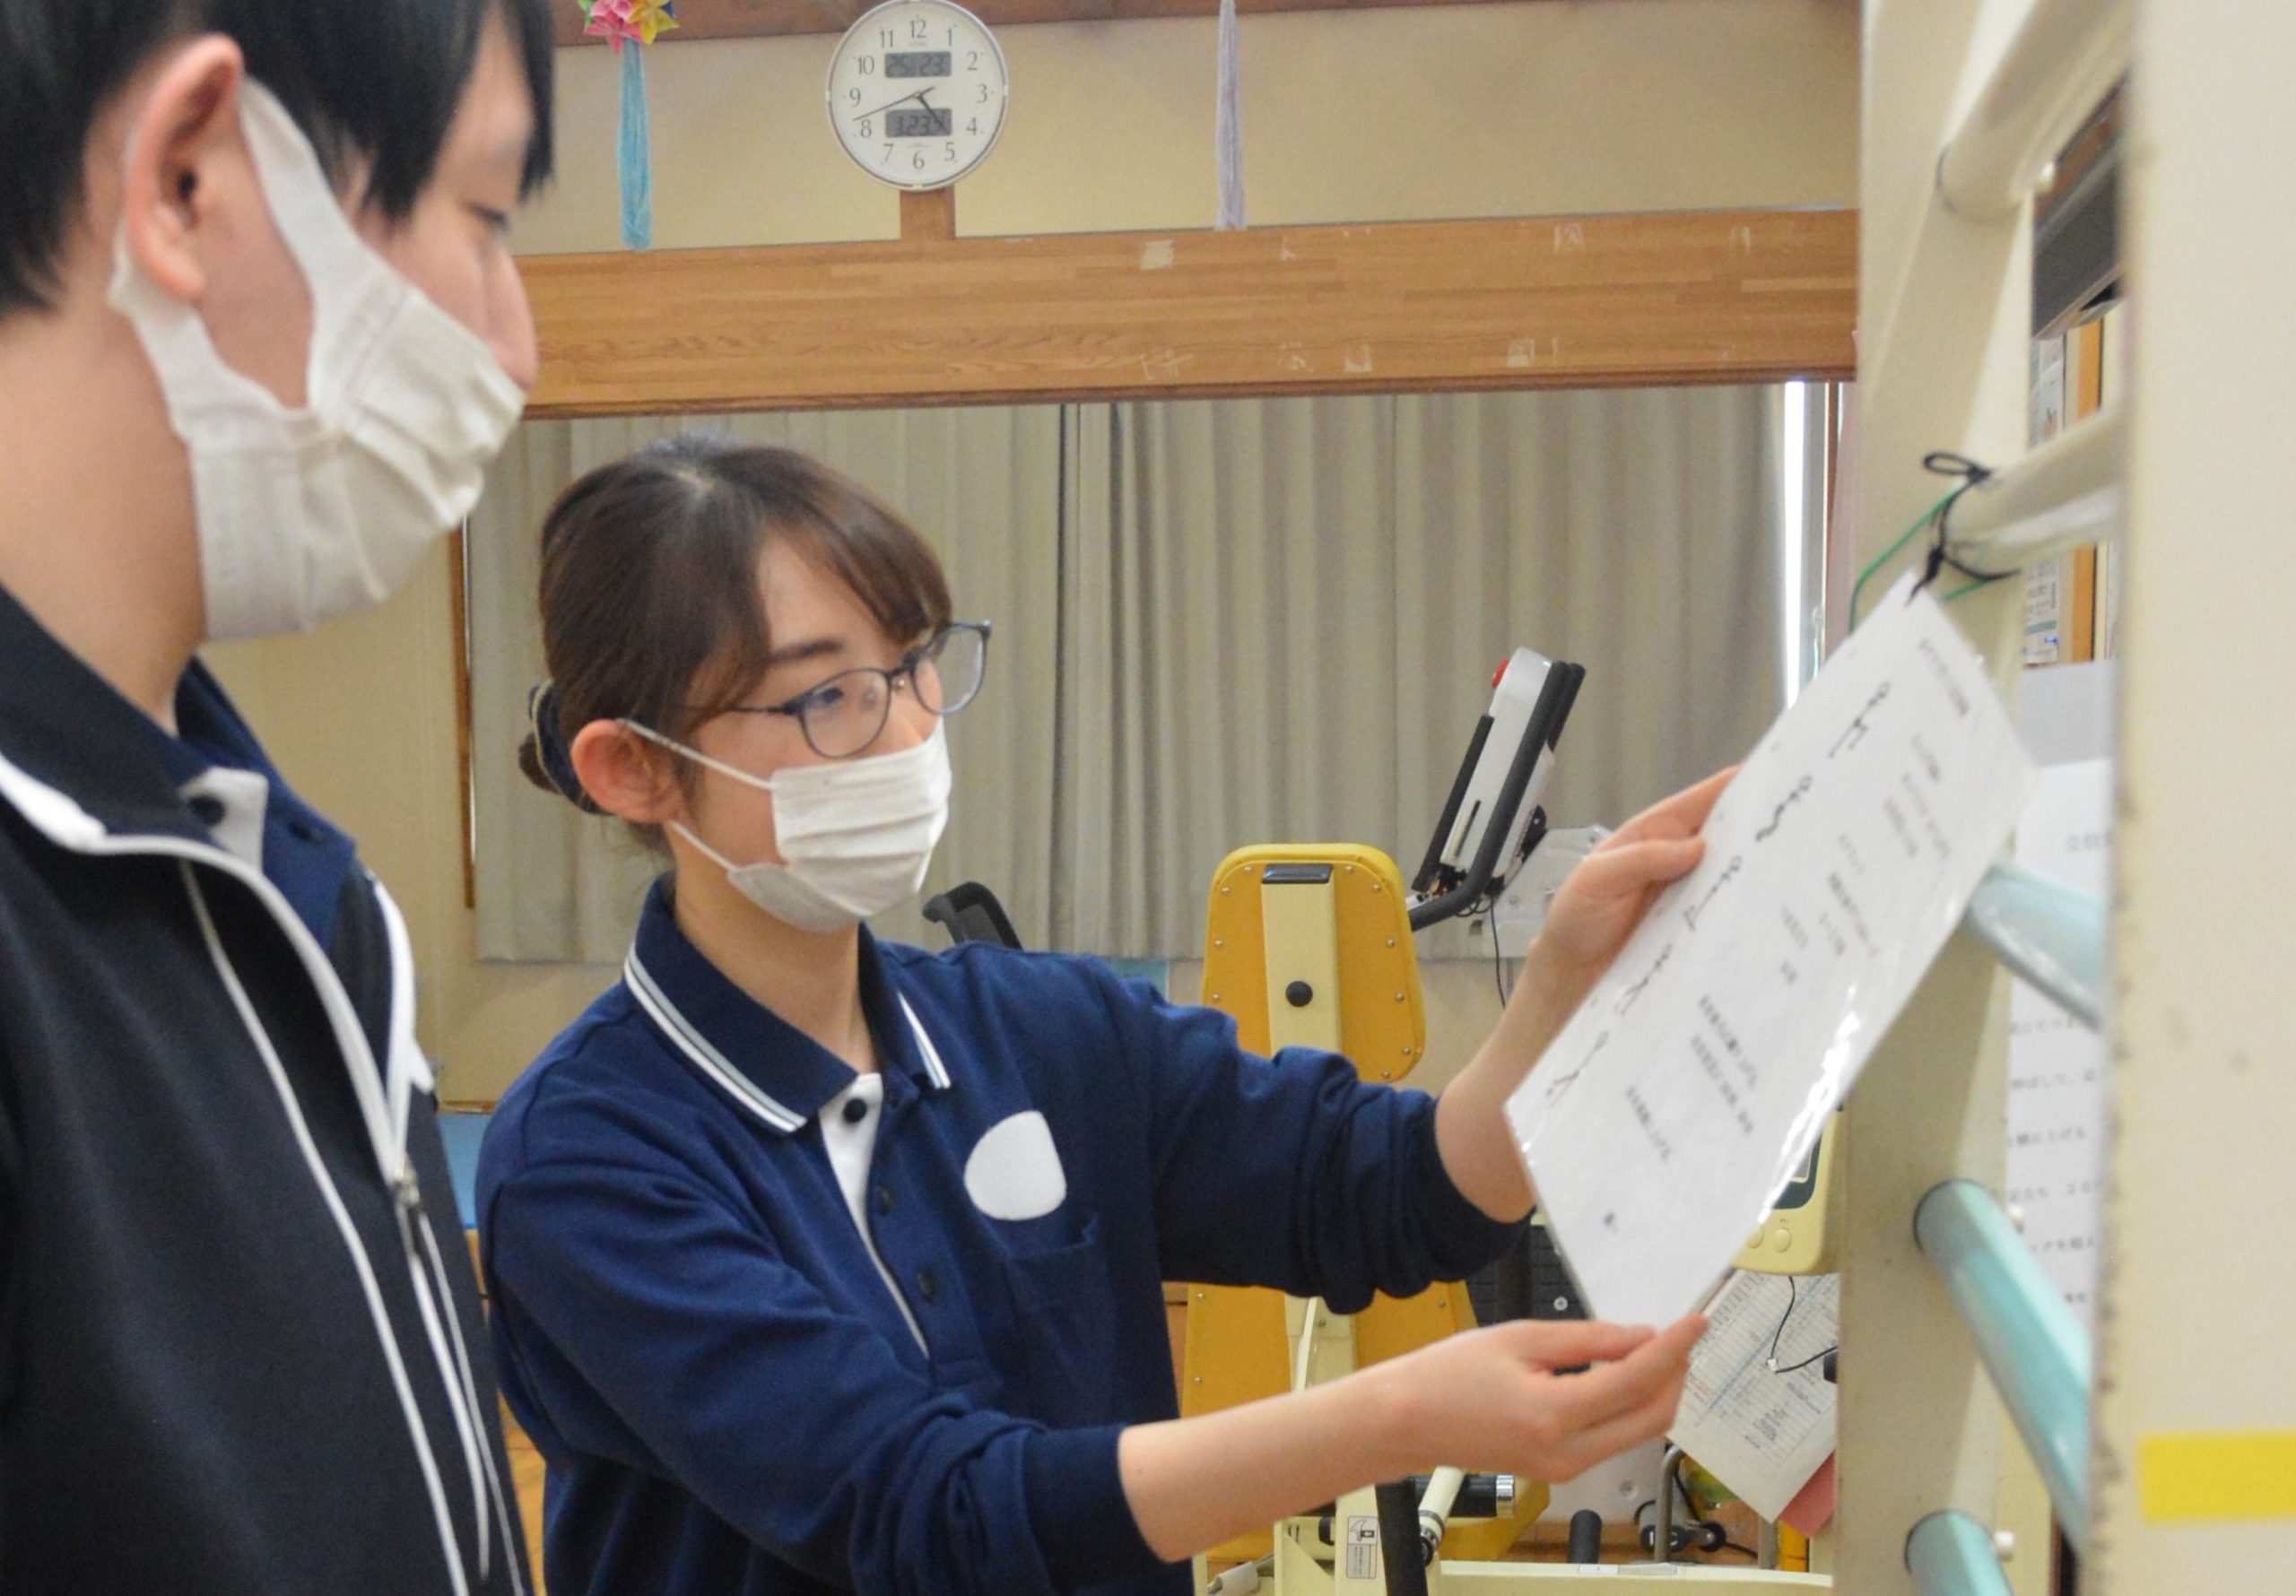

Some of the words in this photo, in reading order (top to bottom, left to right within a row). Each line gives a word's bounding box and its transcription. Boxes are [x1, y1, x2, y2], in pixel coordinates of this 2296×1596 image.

[909, 19, 927, 39] 12
[946, 28, 953, 46] 1
[880, 30, 894, 48] 11
[857, 56, 875, 75] 10
[967, 52, 978, 71] 2
[849, 87, 861, 107] 9
[978, 83, 988, 103] 3
[860, 119, 873, 138] 8
[966, 117, 978, 135] 4
[883, 143, 894, 162] 7
[913, 151, 925, 169] 6
[944, 142, 956, 161] 5
